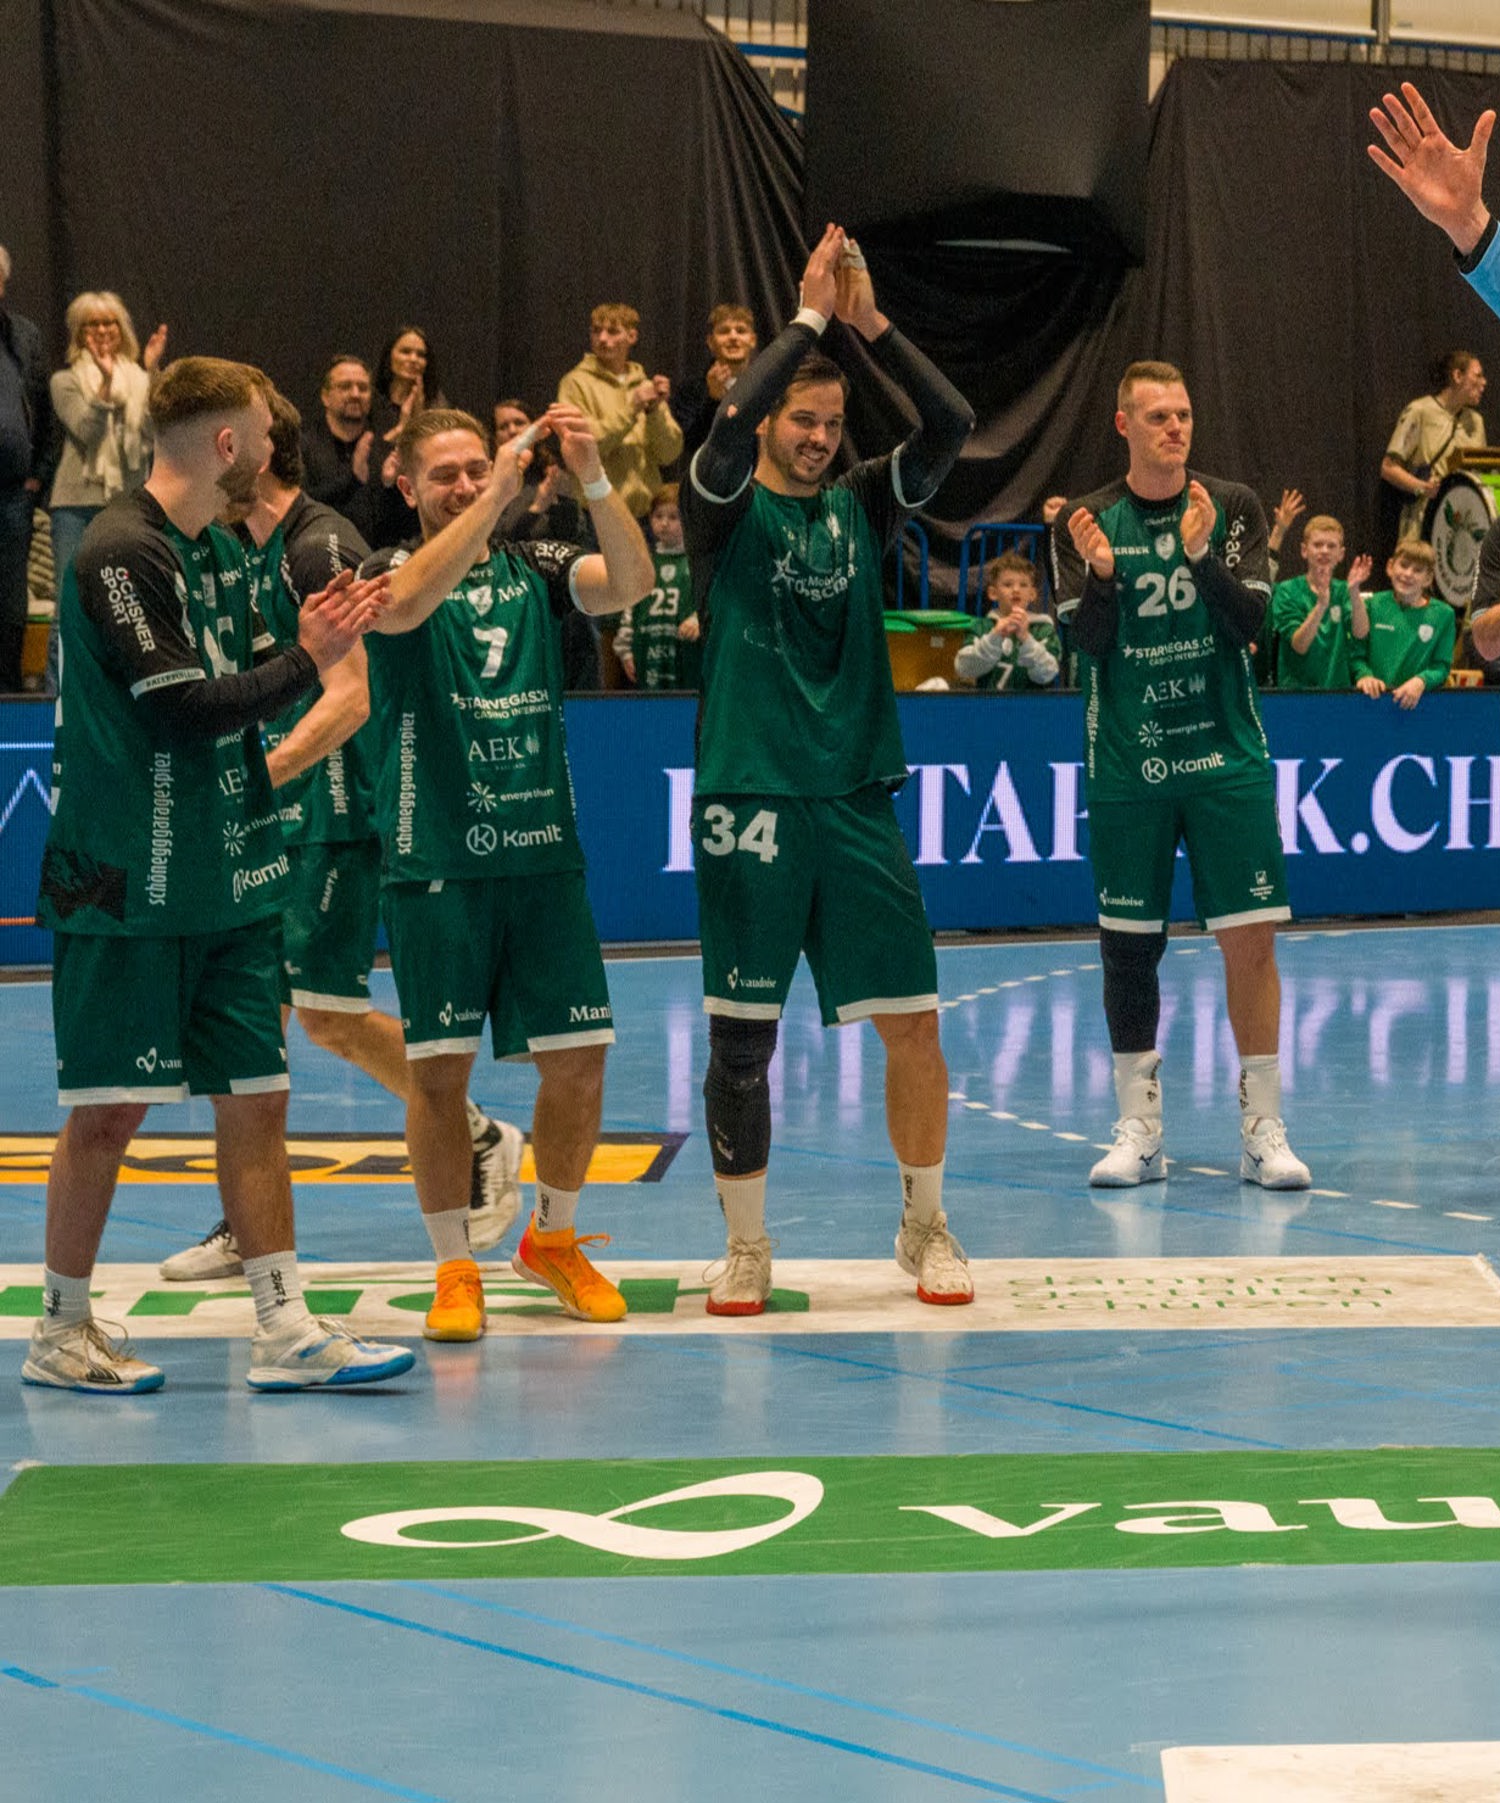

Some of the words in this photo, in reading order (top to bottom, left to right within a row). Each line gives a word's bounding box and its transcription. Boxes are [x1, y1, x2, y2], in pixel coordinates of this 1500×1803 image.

[100, 566, 131, 625] SPORT
[115, 567, 156, 653] OCHSNER
[649, 588, 680, 617] 23
[1134, 565, 1197, 617] 26
[472, 626, 509, 679] 7
[1142, 678, 1187, 704] AEK
[468, 736, 526, 763] AEK
[1172, 751, 1226, 775] Komit
[503, 824, 563, 848] Komit
[702, 803, 779, 864] 34
